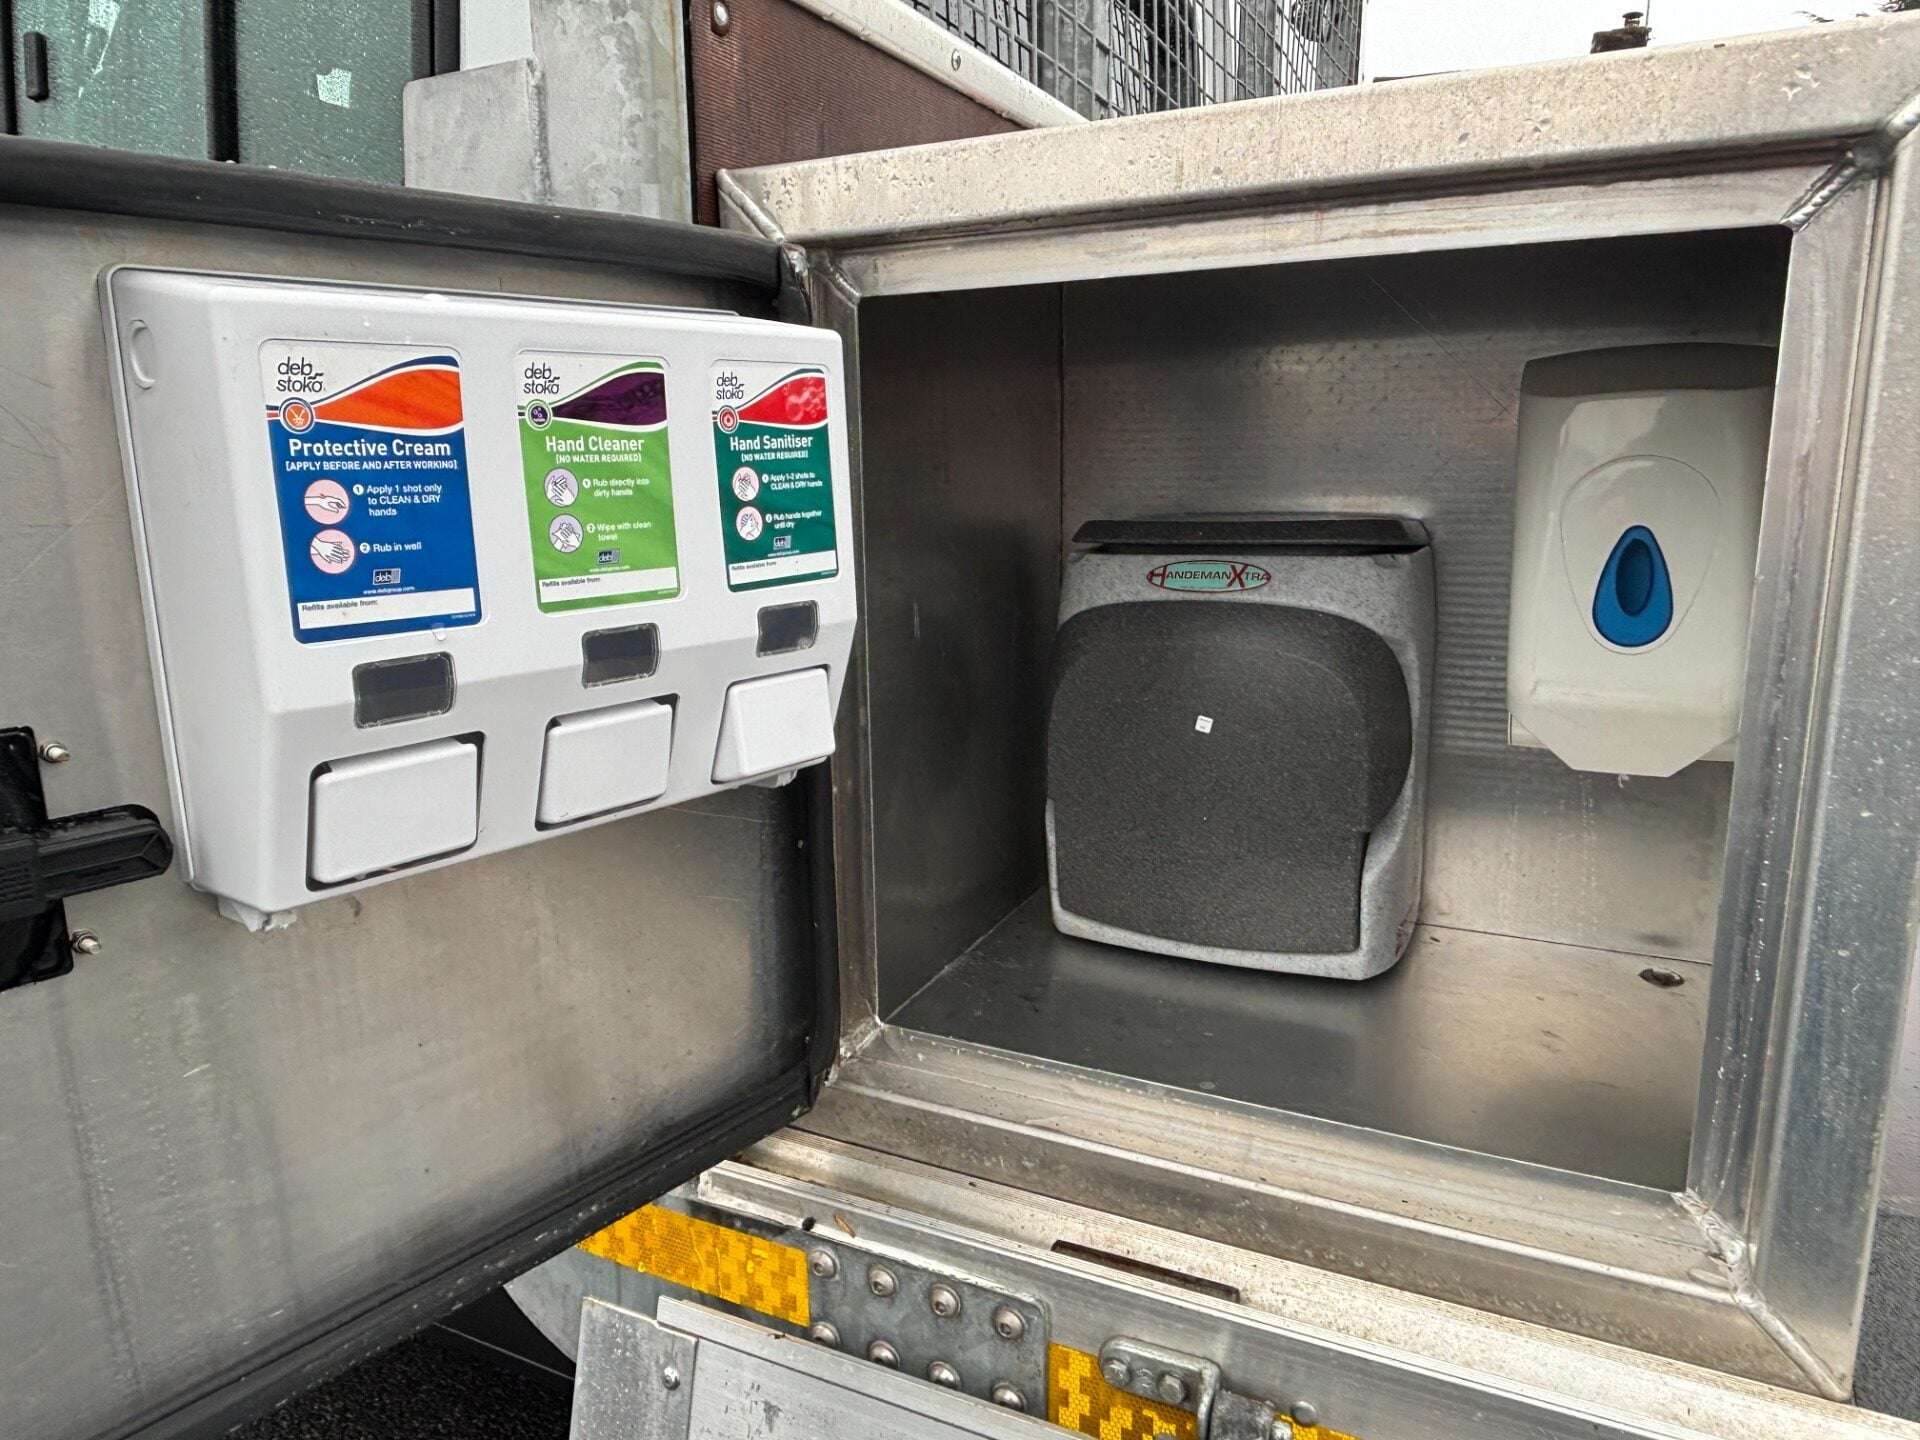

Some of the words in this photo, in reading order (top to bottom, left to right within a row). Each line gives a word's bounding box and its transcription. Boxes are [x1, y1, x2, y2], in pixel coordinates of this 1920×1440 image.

[277, 356, 313, 377] deb
[524, 362, 552, 380] deb
[276, 376, 325, 393] stoko
[716, 371, 738, 387] deb
[523, 379, 560, 394] stoko
[716, 388, 744, 400] stoko
[288, 438, 388, 457] Protective
[392, 440, 451, 456] Cream
[545, 435, 585, 452] Hand
[588, 435, 645, 452] Cleaner
[729, 435, 760, 451] Hand
[763, 434, 814, 450] Sanitiser
[572, 454, 600, 463] WATER
[753, 451, 776, 461] WATER
[322, 460, 361, 471] BEFORE
[361, 460, 382, 470] AND
[383, 460, 412, 470] AFTER
[592, 478, 608, 487] Rub
[366, 484, 393, 495] Apply
[394, 484, 400, 493] 1
[402, 484, 422, 493] shot
[423, 483, 442, 494] only
[593, 489, 610, 499] dirty
[367, 497, 378, 505] to
[379, 495, 412, 504] CLEAN
[413, 495, 421, 503] &
[422, 494, 441, 503] DRY
[368, 508, 397, 516] hands
[372, 543, 392, 552] Rub
[393, 542, 403, 551] in
[404, 541, 422, 550] well
